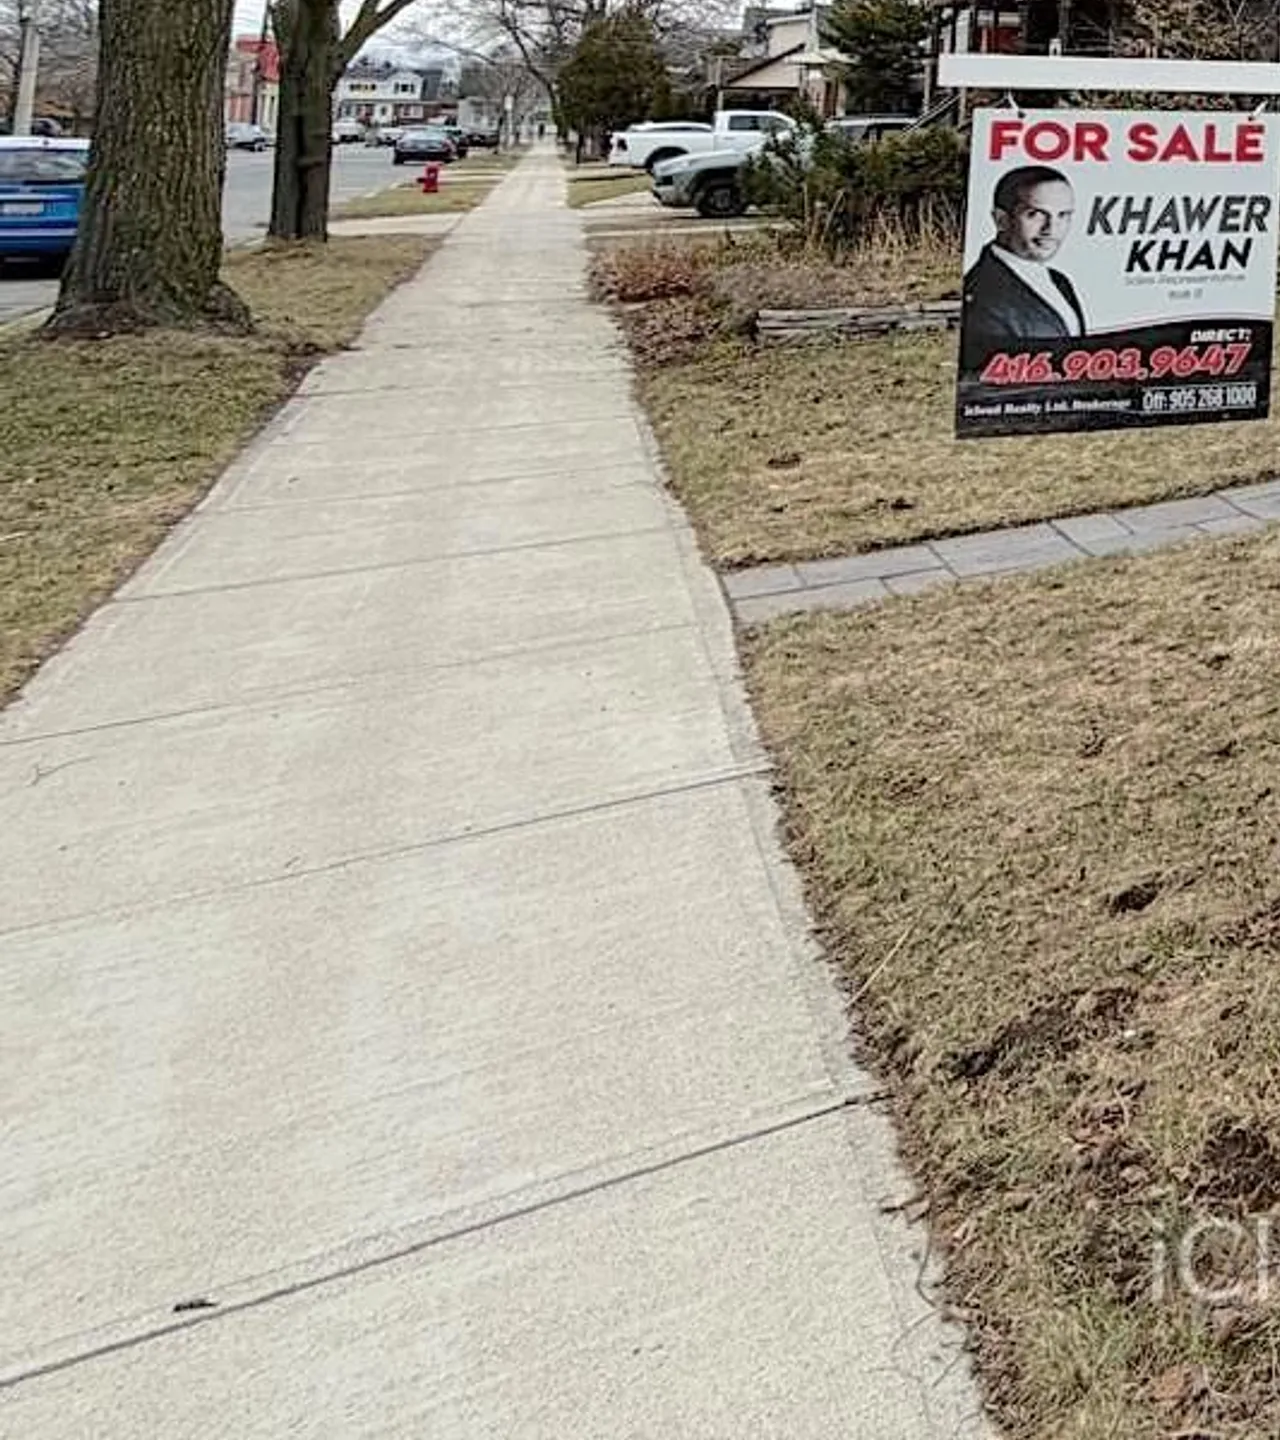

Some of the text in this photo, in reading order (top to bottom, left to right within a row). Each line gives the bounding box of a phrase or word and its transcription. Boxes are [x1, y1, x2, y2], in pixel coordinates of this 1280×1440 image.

[989, 121, 1266, 162] FOR SALE
[1087, 195, 1271, 235] KHAWER
[1125, 238, 1253, 272] KHAN
[980, 343, 1251, 384] 416.903.9647
